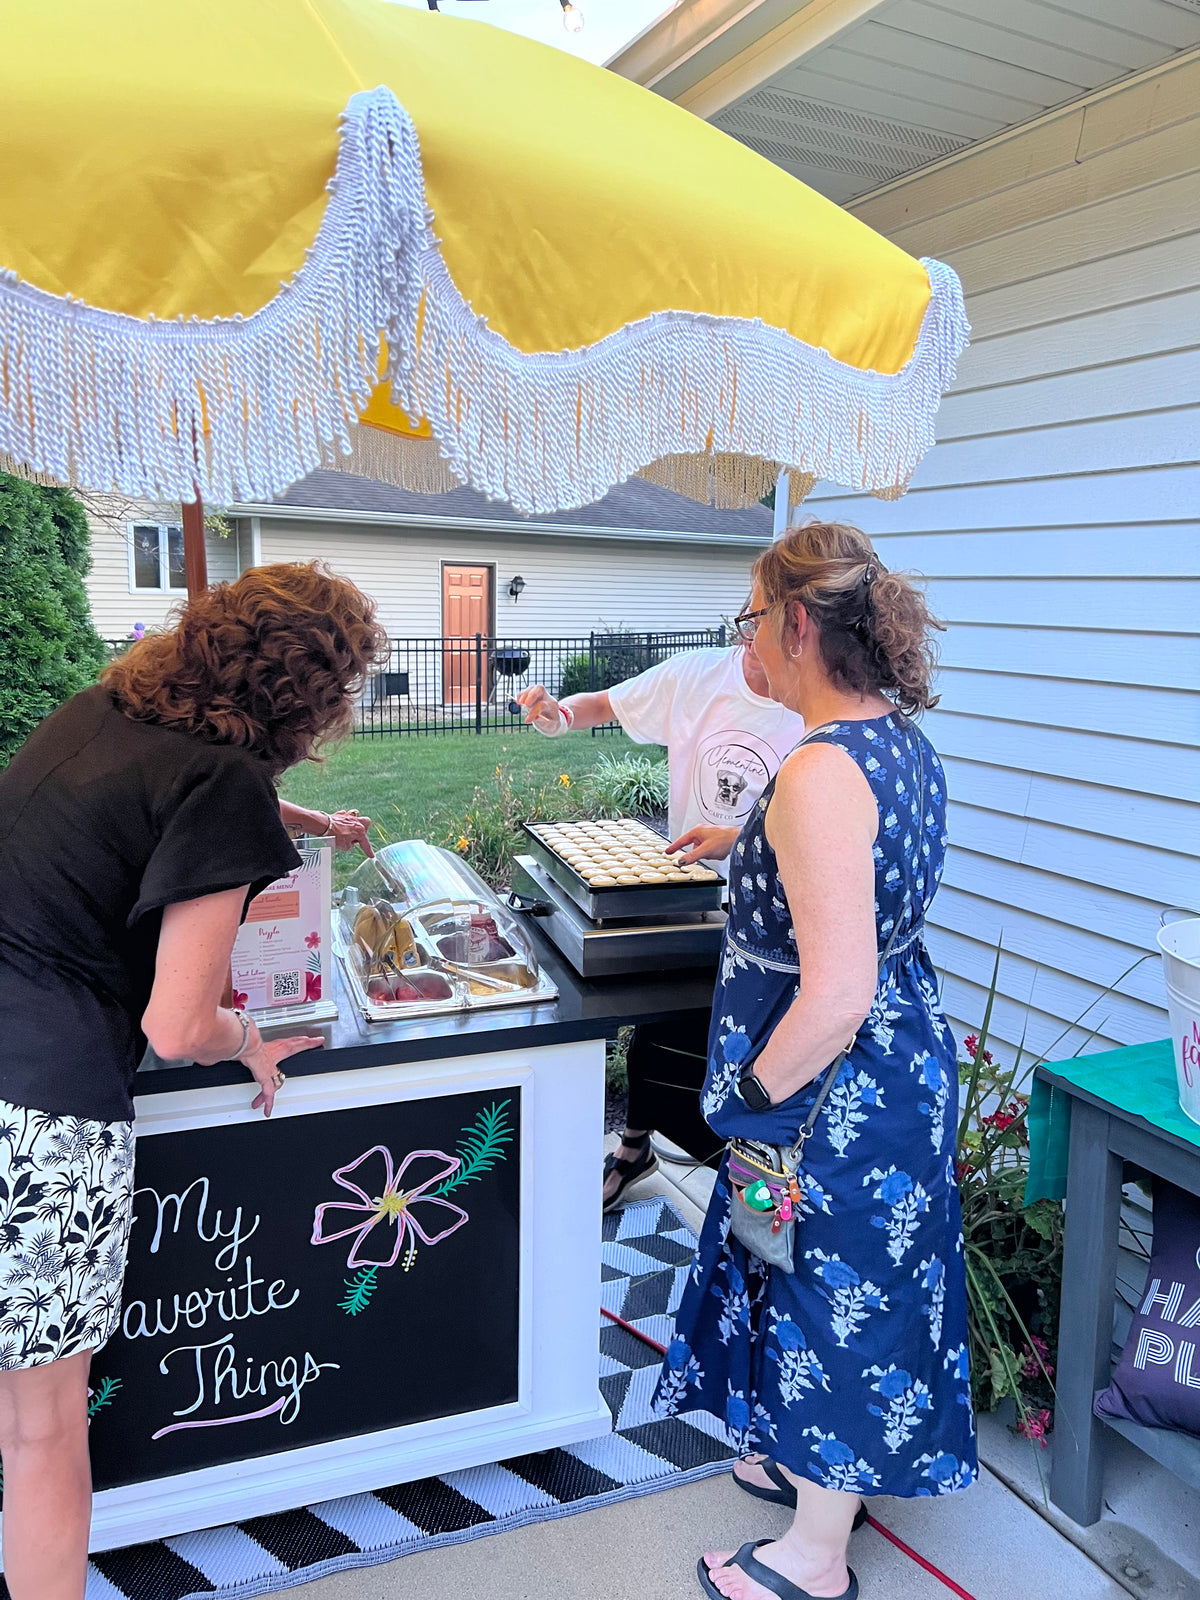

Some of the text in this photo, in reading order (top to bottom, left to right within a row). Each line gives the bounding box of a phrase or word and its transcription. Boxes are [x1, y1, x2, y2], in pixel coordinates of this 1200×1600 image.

[708, 809, 723, 819] CART
[276, 881, 293, 889] MENU
[131, 1176, 260, 1271] My
[122, 1255, 300, 1340] avorite
[160, 1332, 341, 1425] Things
